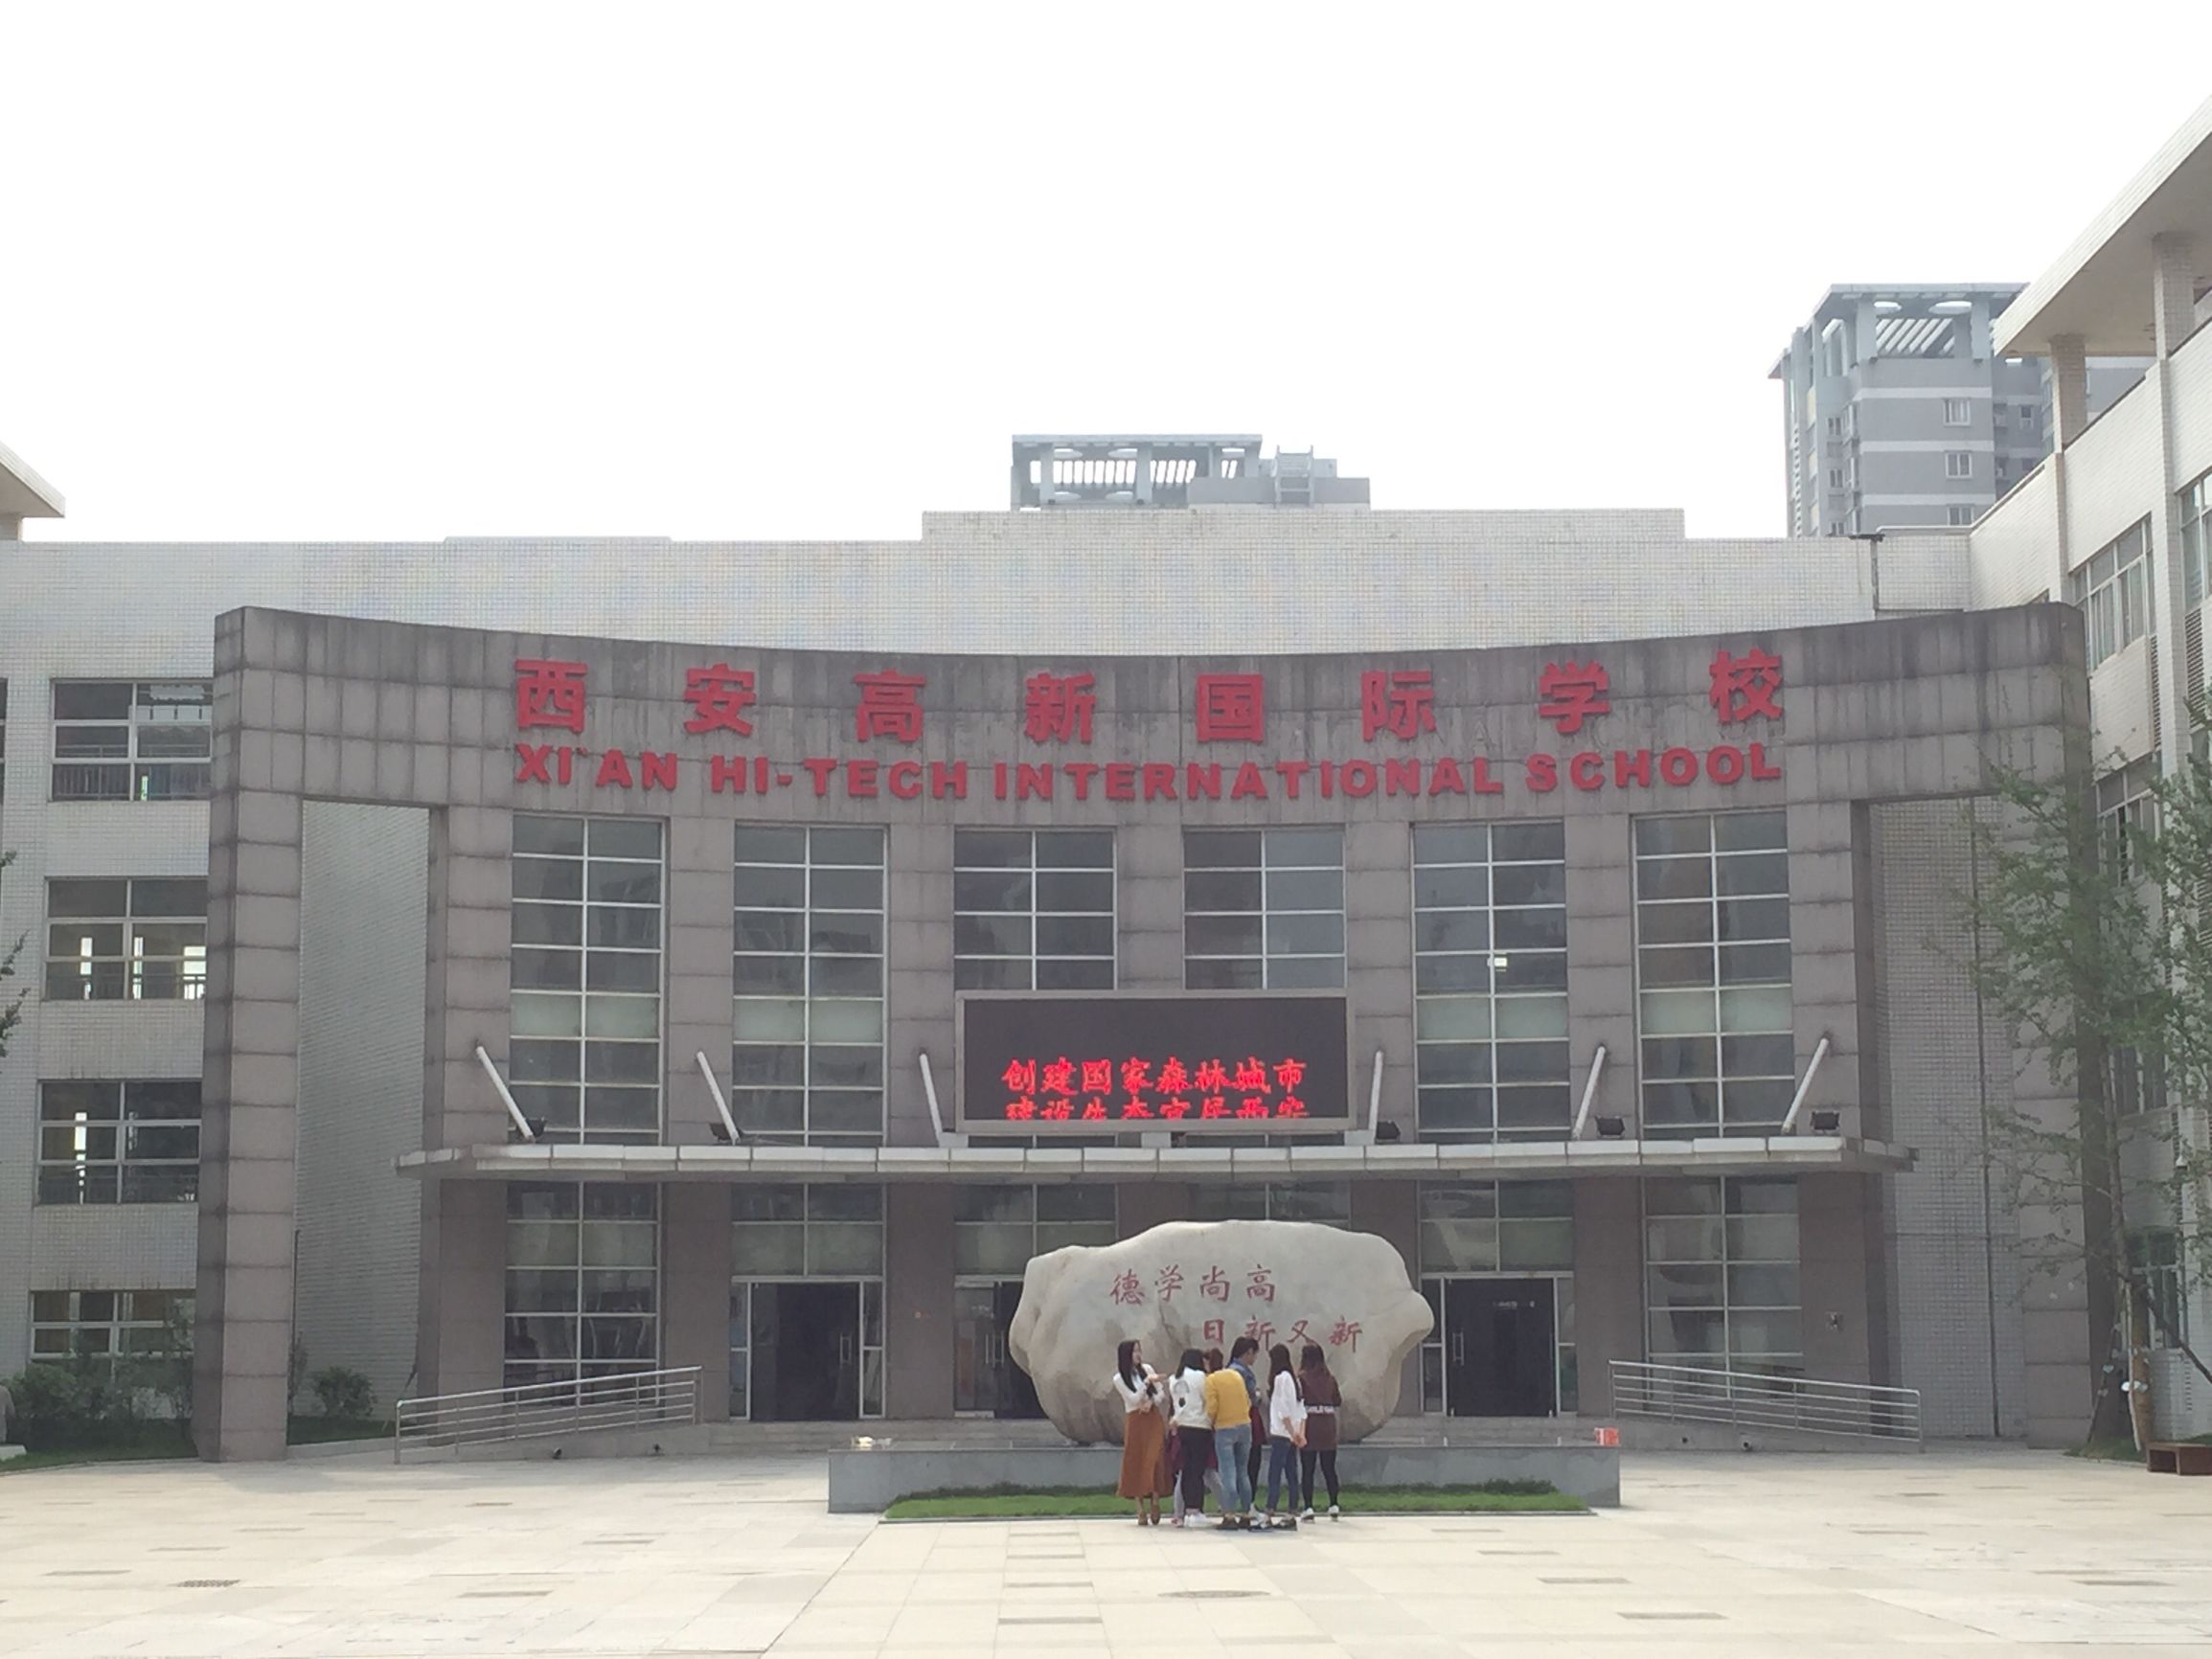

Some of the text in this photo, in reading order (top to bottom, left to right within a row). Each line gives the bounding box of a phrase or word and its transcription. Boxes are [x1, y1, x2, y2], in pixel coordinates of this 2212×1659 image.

[515, 648, 1783, 743] 西安高新国际学校
[710, 754, 968, 799] HI-TECH
[994, 757, 1503, 800] INTERNATIONAL
[1525, 741, 1780, 793] SCHOOL
[1001, 1056, 1308, 1096] 创建国家森林城市
